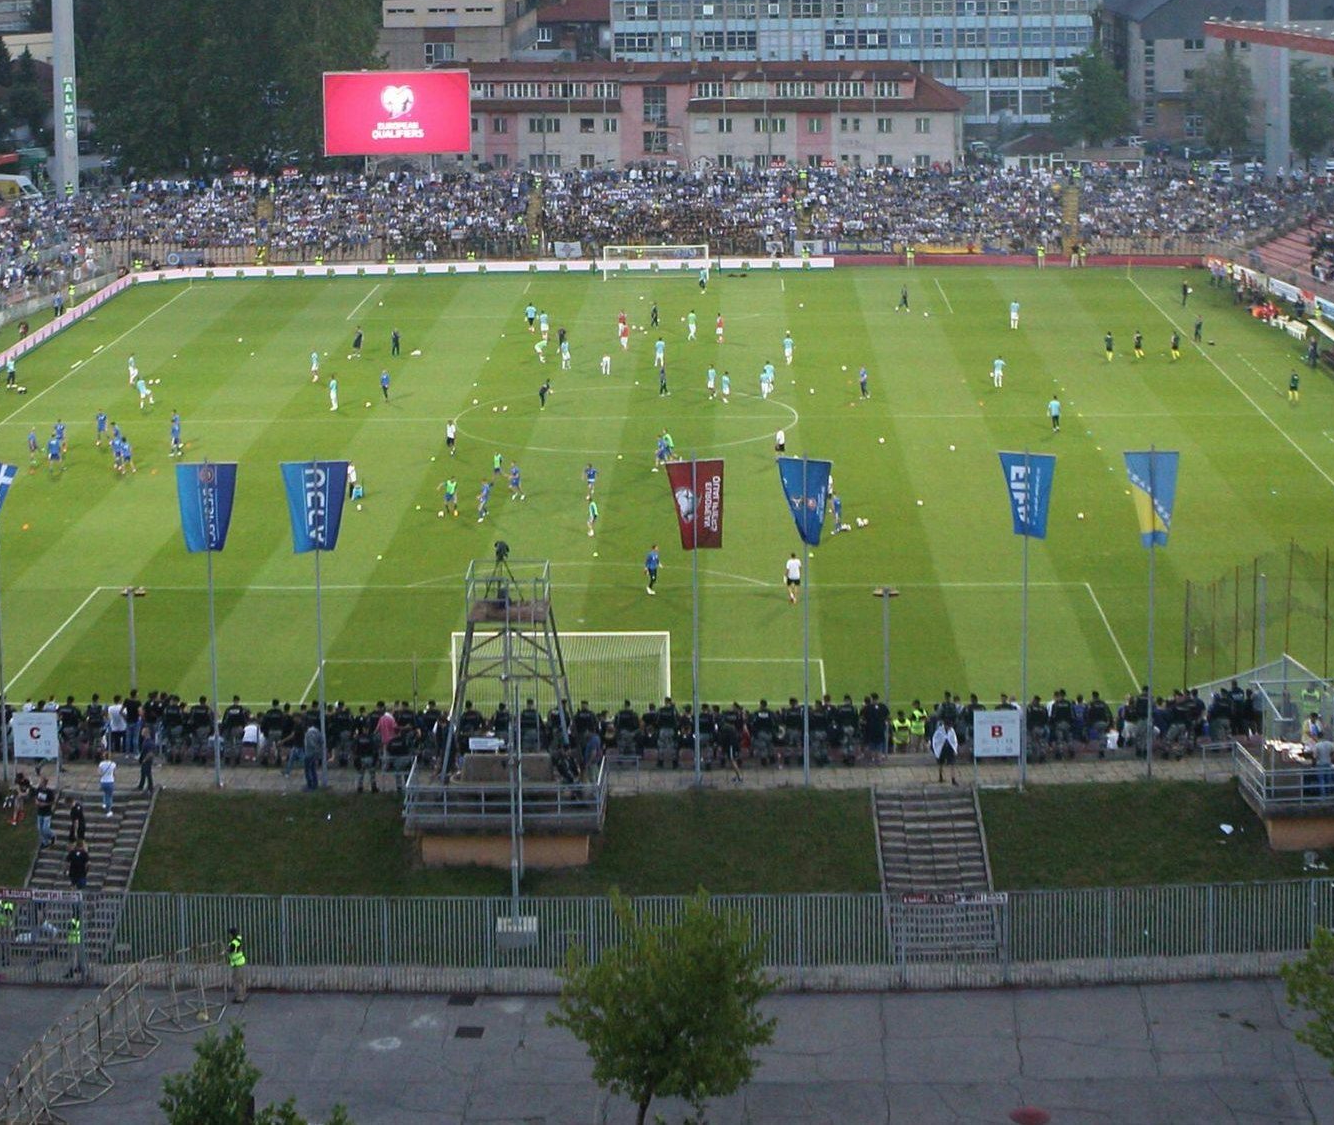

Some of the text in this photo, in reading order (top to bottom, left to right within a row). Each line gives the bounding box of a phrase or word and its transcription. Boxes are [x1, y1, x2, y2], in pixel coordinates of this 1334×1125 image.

[64, 83, 74, 124] ALMY
[372, 129, 424, 139] QUALIFIERS
[29, 726, 41, 739] C
[991, 725, 1003, 738] B
